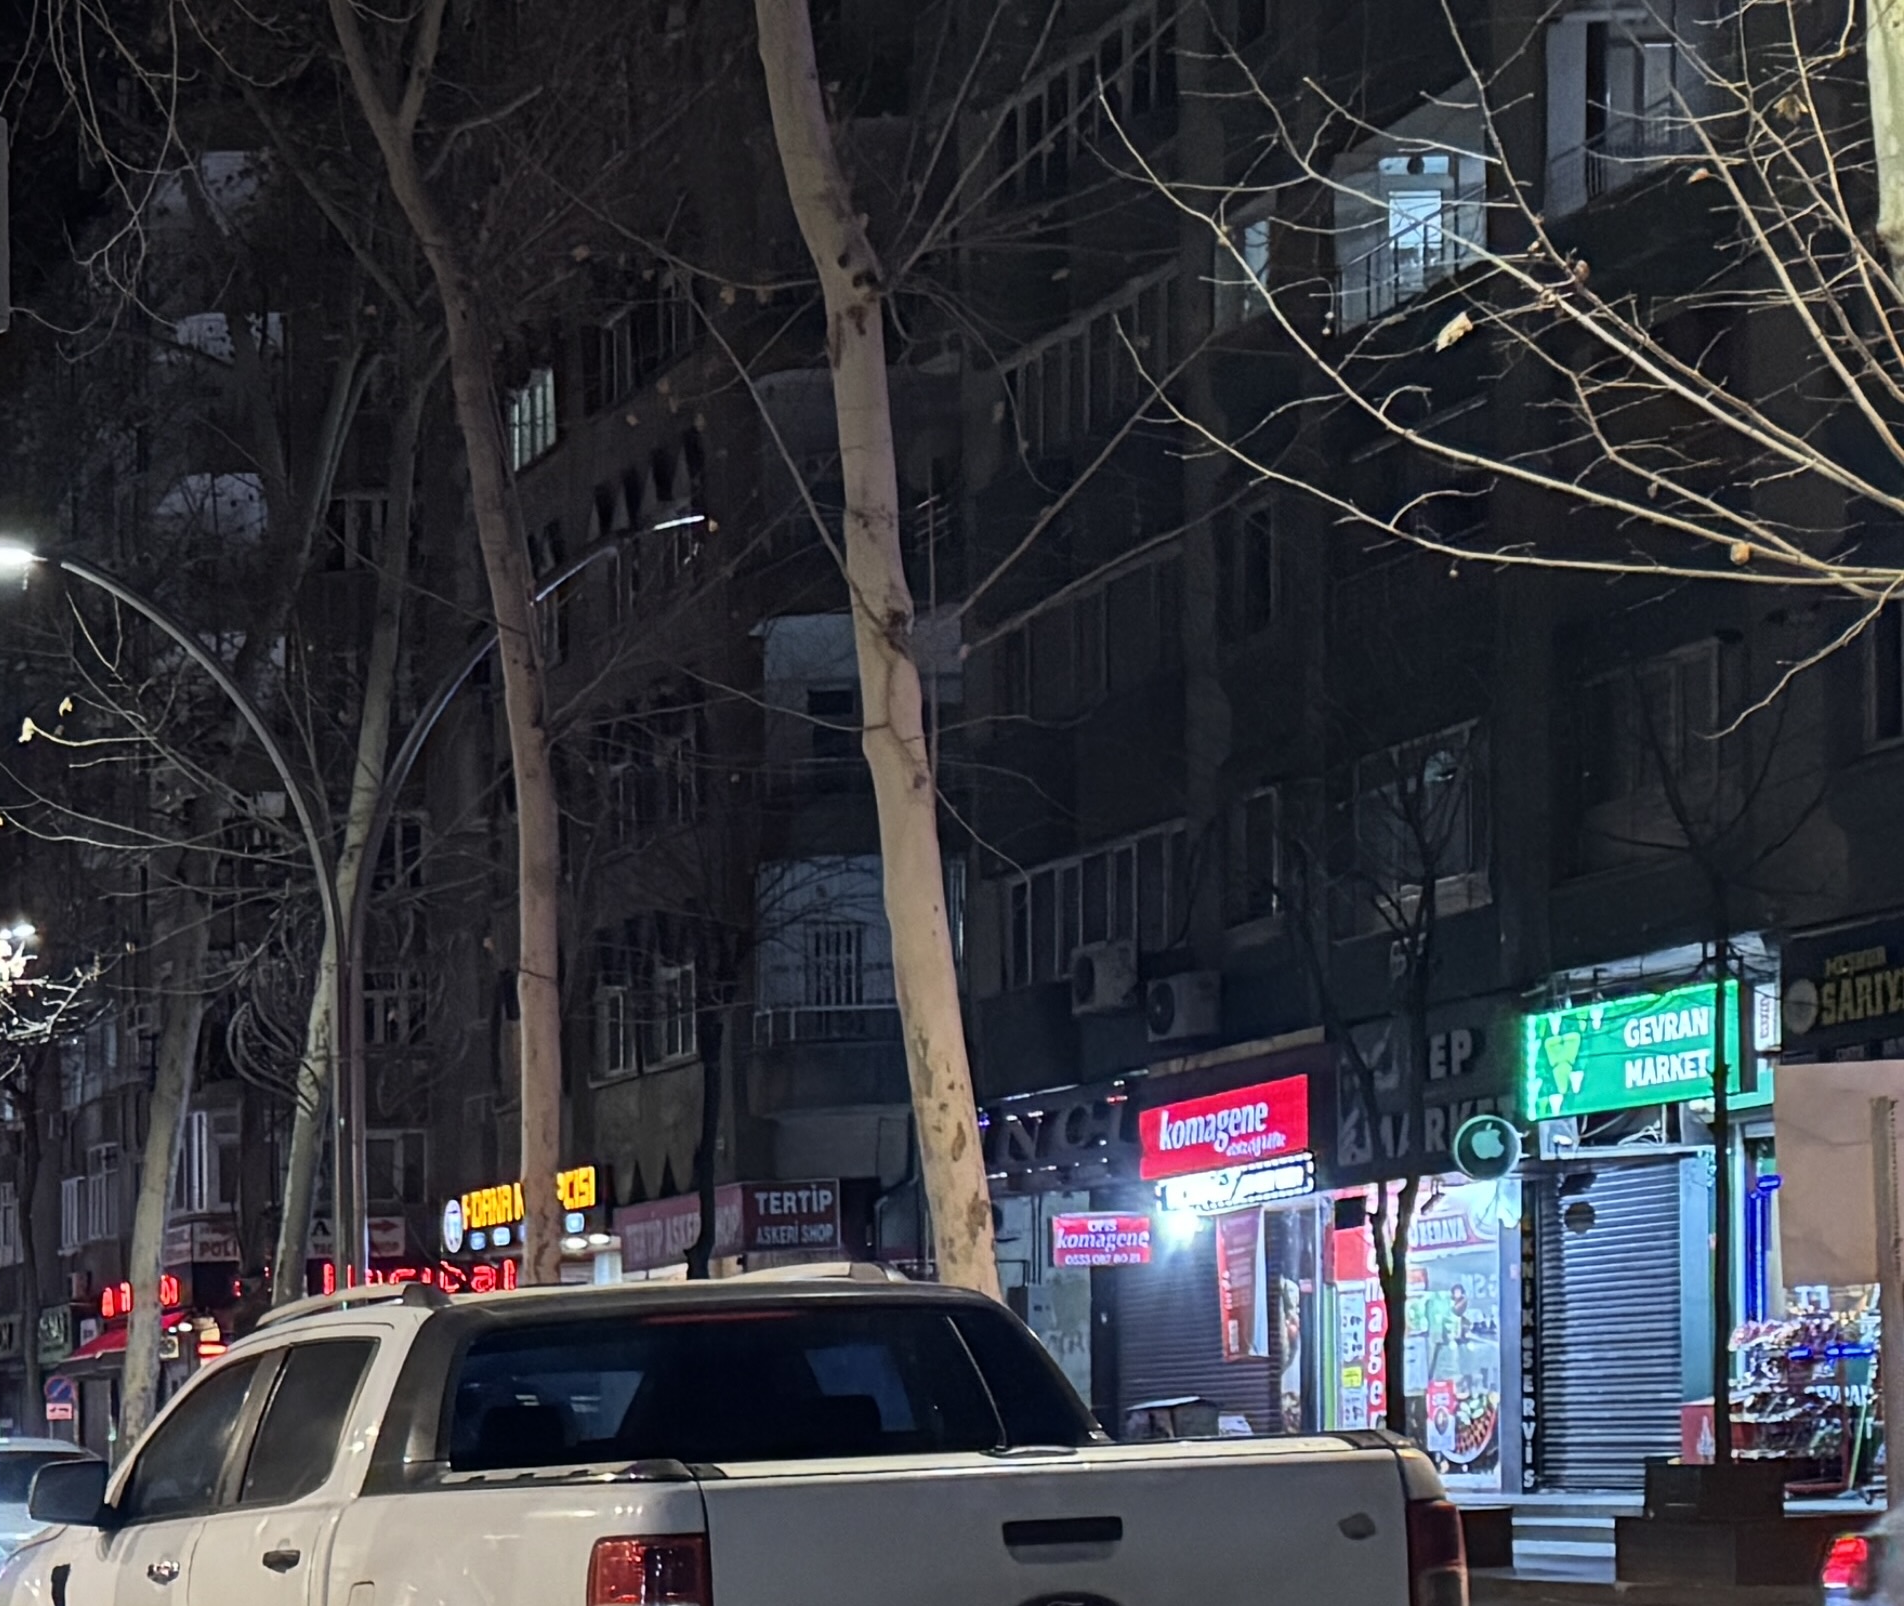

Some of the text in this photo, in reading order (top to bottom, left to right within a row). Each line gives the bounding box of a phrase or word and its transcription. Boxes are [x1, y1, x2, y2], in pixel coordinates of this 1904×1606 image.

[1623, 1007, 1710, 1047] GEVRAN
[1624, 1050, 1711, 1090] MARKET
[1159, 1102, 1269, 1153] komagene
[755, 1184, 833, 1216] TERTİP
[801, 1224, 834, 1243] SHOP
[1057, 1228, 1150, 1252] komagene
